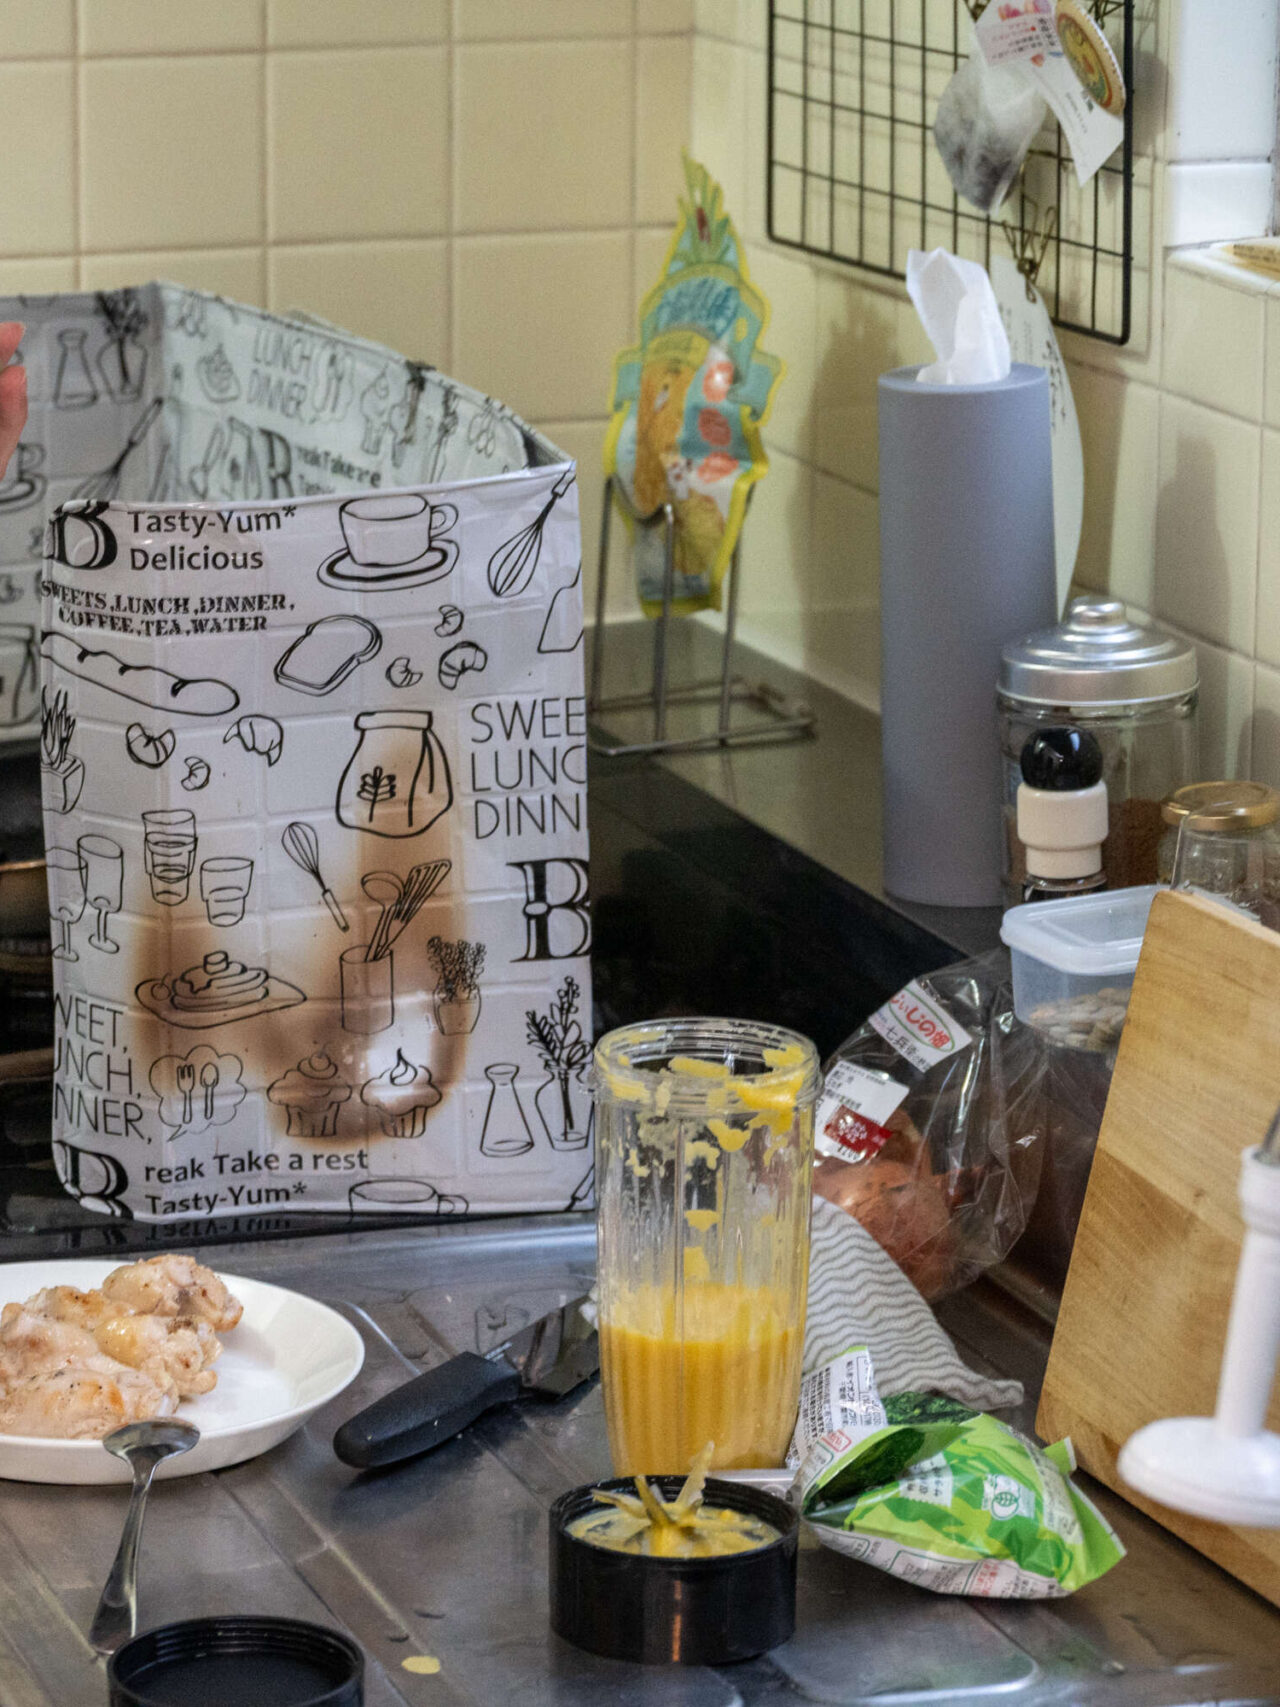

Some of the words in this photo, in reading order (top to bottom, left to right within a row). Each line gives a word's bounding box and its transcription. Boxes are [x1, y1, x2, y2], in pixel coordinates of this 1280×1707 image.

[130, 545, 264, 571] Delicious
[471, 697, 587, 744] SWEE
[472, 744, 587, 793] LUNC
[474, 793, 580, 839] DINN
[506, 857, 591, 962] B
[145, 1158, 204, 1184] reak
[214, 1150, 280, 1174] Take
[289, 1153, 303, 1170] a
[313, 1149, 368, 1171] rest
